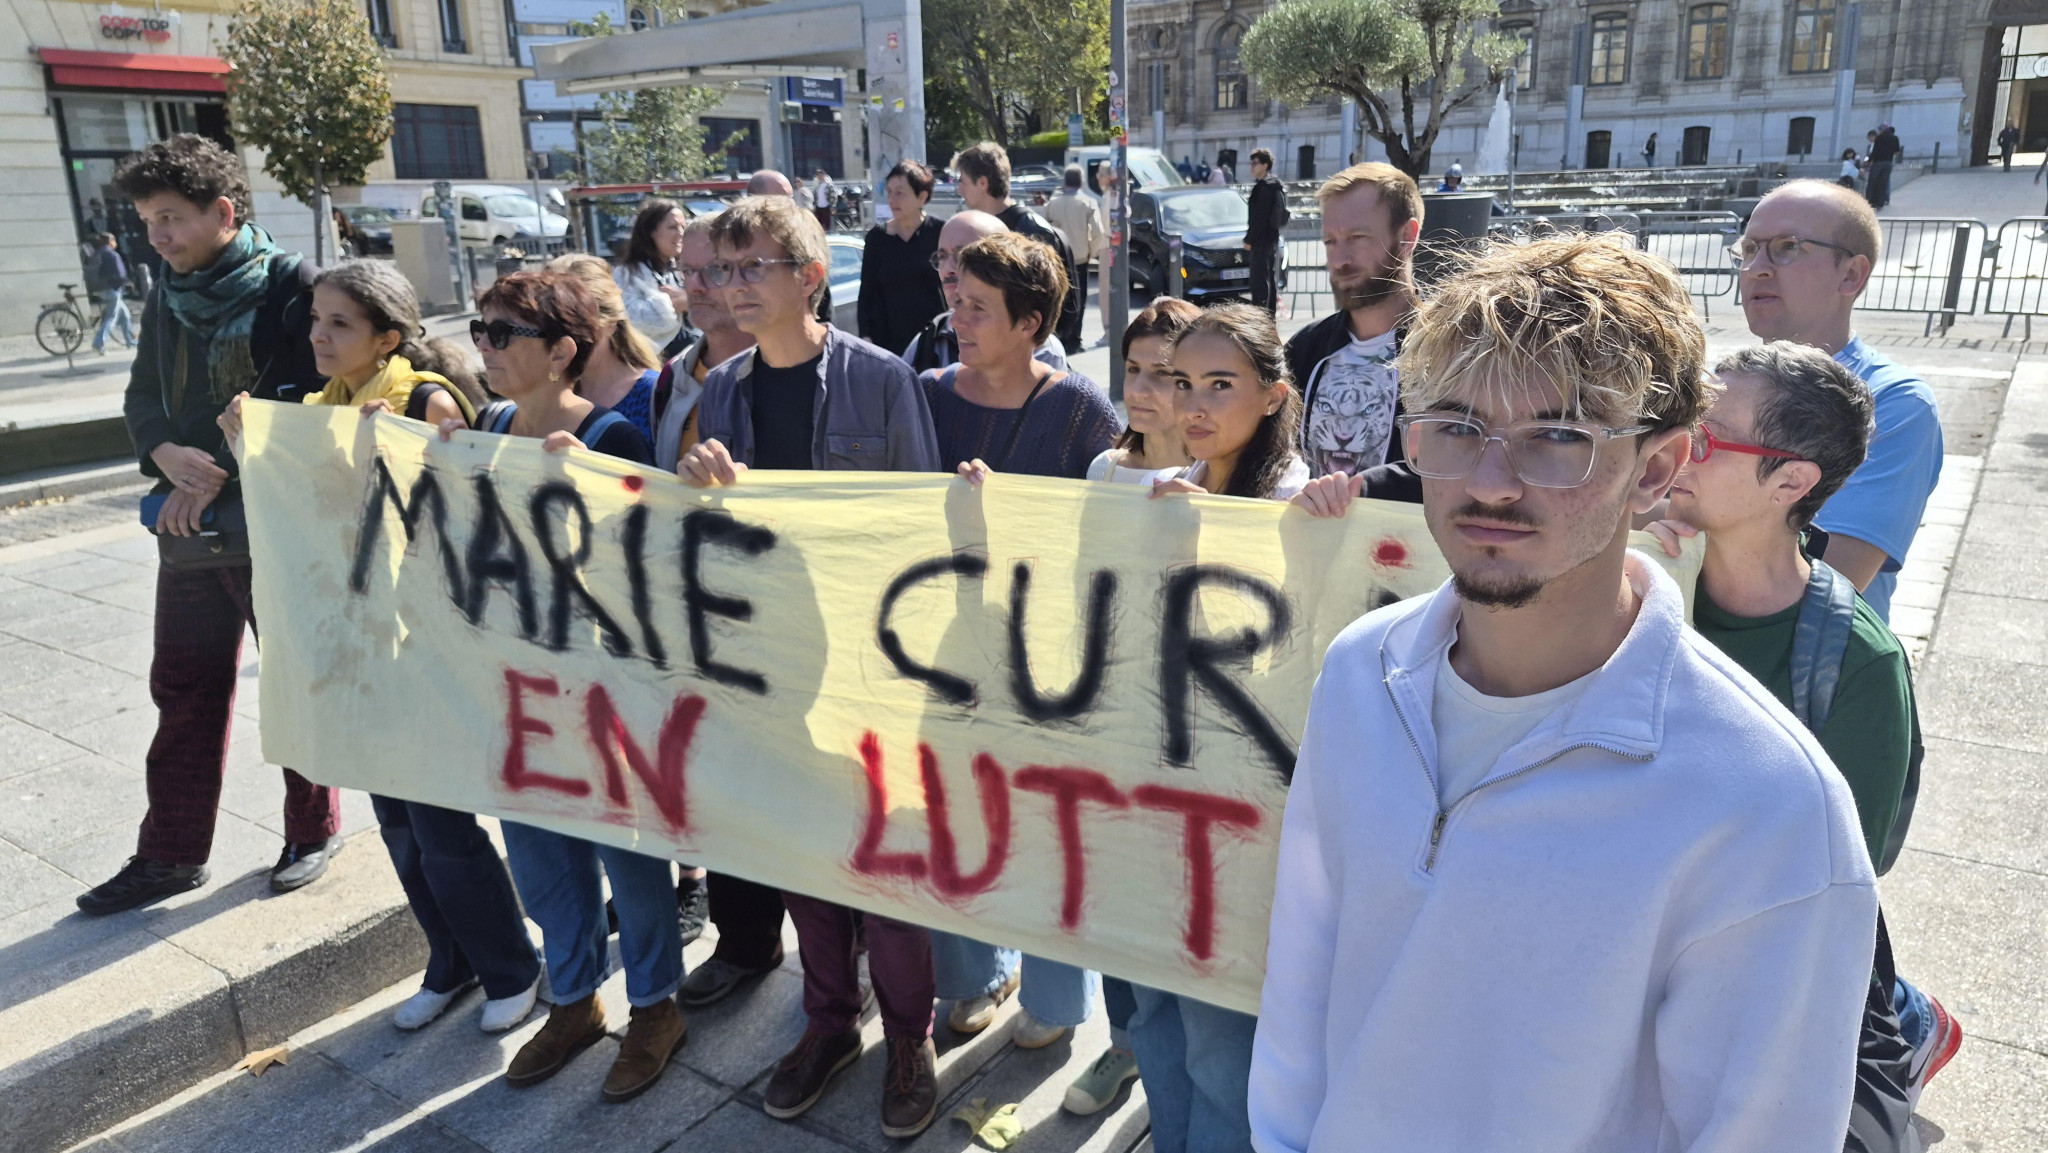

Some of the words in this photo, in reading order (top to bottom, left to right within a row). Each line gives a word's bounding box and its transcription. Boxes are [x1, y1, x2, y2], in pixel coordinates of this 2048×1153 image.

[876, 541, 1408, 784] CUR
[503, 669, 705, 831] EN
[852, 732, 1260, 960] LUTT
